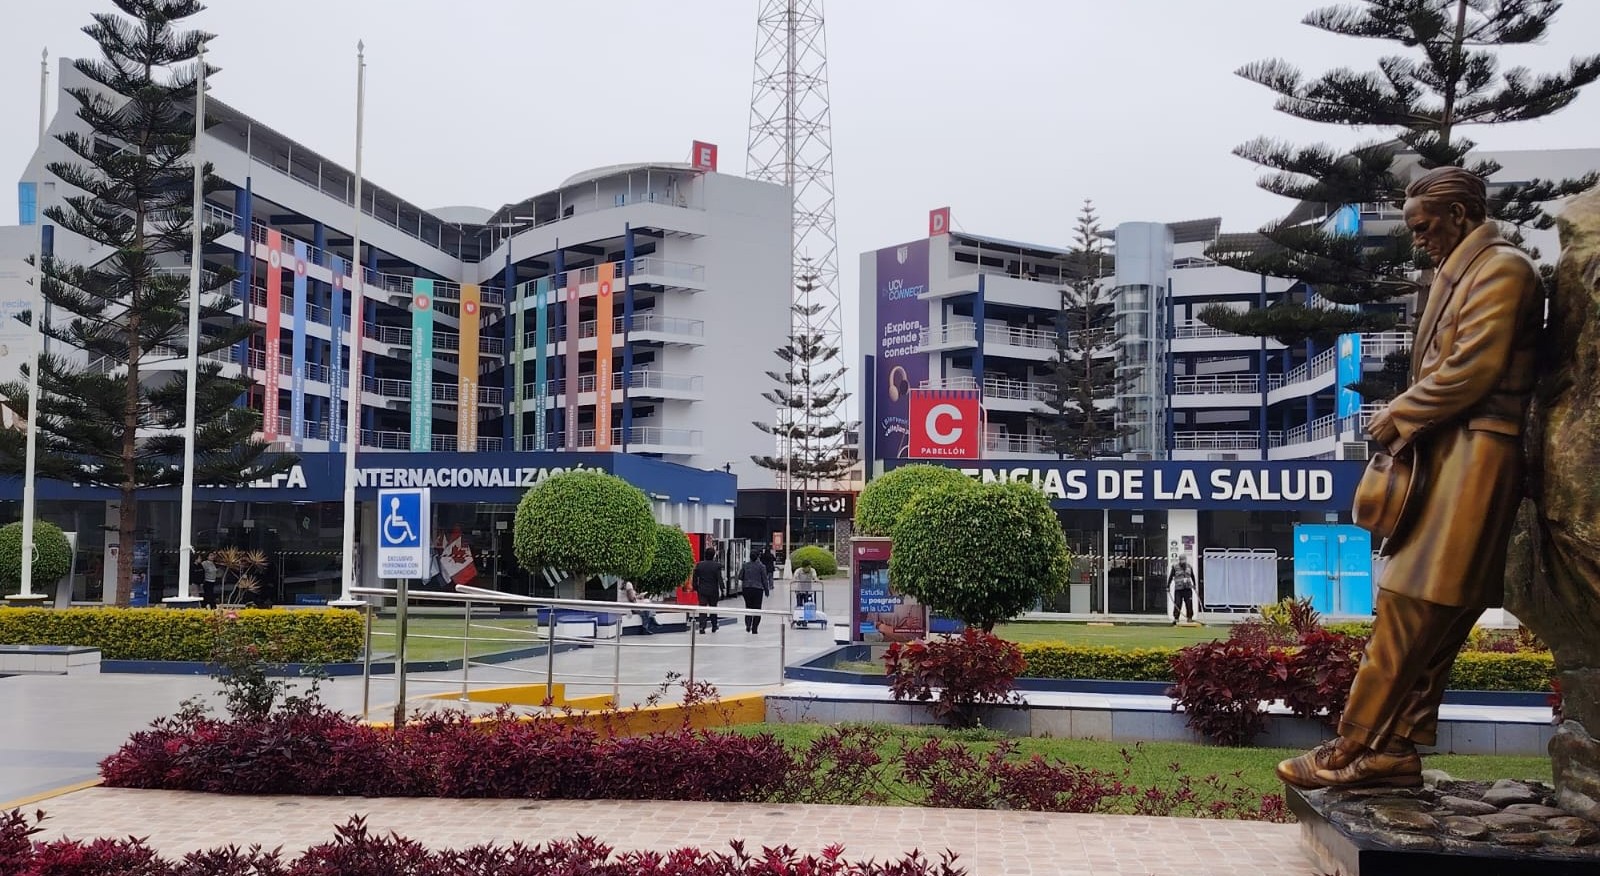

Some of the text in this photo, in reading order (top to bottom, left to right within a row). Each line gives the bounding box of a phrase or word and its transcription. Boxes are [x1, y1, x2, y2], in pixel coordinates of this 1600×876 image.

[700, 147, 712, 166] E
[933, 214, 943, 231] D
[889, 279, 903, 291] UCV
[889, 285, 924, 300] CONNECT
[415, 328, 423, 358] Terapia
[882, 331, 918, 348] aprende
[416, 360, 421, 370] en
[423, 358, 431, 417] Rehabilitación
[461, 383, 469, 407] Física
[413, 404, 422, 450] Tecnología
[460, 408, 468, 452] Educación
[925, 403, 963, 445] C
[422, 426, 430, 450] Física
[921, 447, 965, 455] PABELLÓN
[236, 465, 308, 489] LFA
[353, 462, 604, 487] NTERNACIONALIZA
[950, 468, 1333, 501] NIAS DE LA SALUD
[861, 588, 884, 596] Estudia
[868, 597, 901, 605] posgrado
